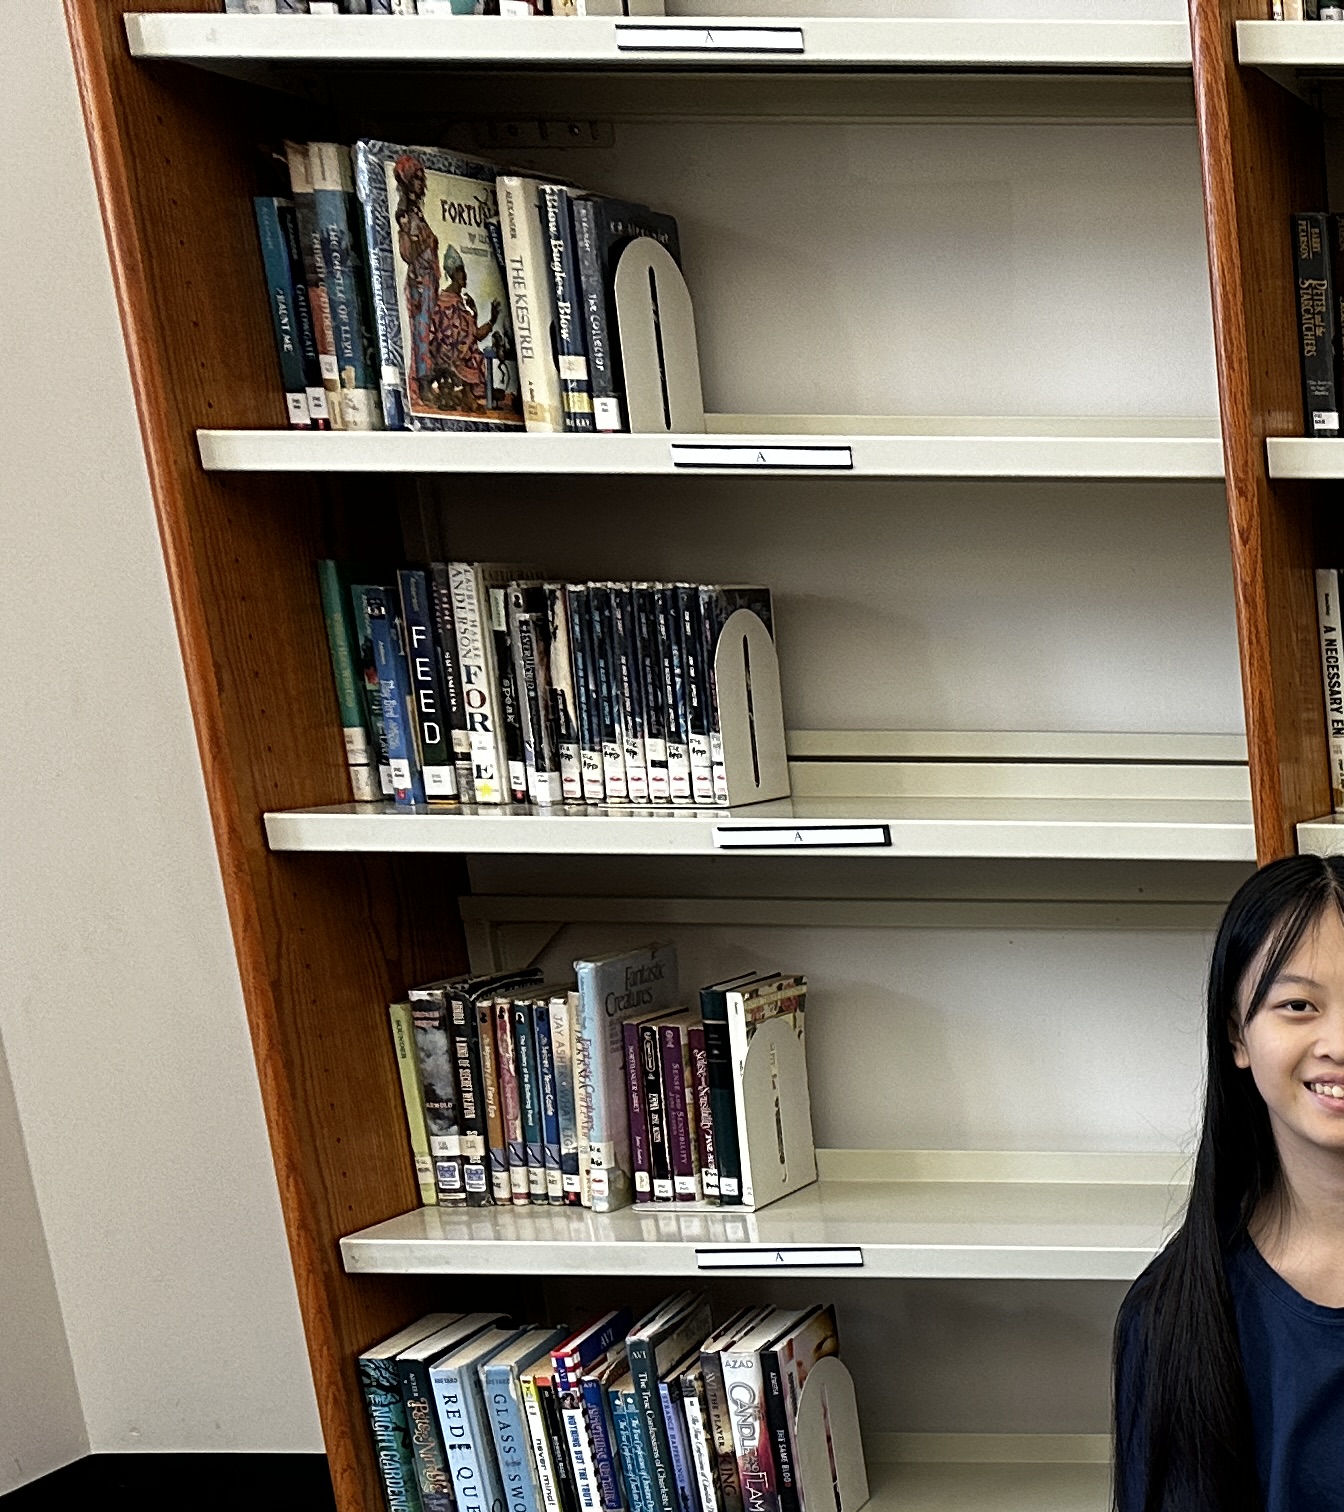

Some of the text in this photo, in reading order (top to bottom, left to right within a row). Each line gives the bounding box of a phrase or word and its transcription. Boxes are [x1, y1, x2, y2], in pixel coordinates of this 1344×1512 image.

[509, 256, 534, 364] THE KESTREL
[1299, 279, 1315, 356] STARCATCHERS
[1313, 280, 1327, 312] PETER
[756, 451, 767, 463] A
[450, 568, 471, 659] ANDERSON
[411, 626, 441, 745] FEED
[1324, 625, 1343, 714] A NECESSARY
[794, 831, 804, 842] A
[624, 962, 666, 991] Fantastic
[605, 989, 653, 1018] Creatures
[553, 1014, 568, 1076] JAY ASHER
[775, 1252, 785, 1263] A
[371, 1406, 397, 1447] NIGHT
[442, 1394, 465, 1438] RED
[493, 1394, 516, 1454] GLASS
[712, 1414, 725, 1448] PLAYER
[728, 1382, 761, 1456] CANDLE
[566, 1415, 594, 1508] NOTHING BUT THE TRUTH
[717, 1453, 737, 1497] KING
